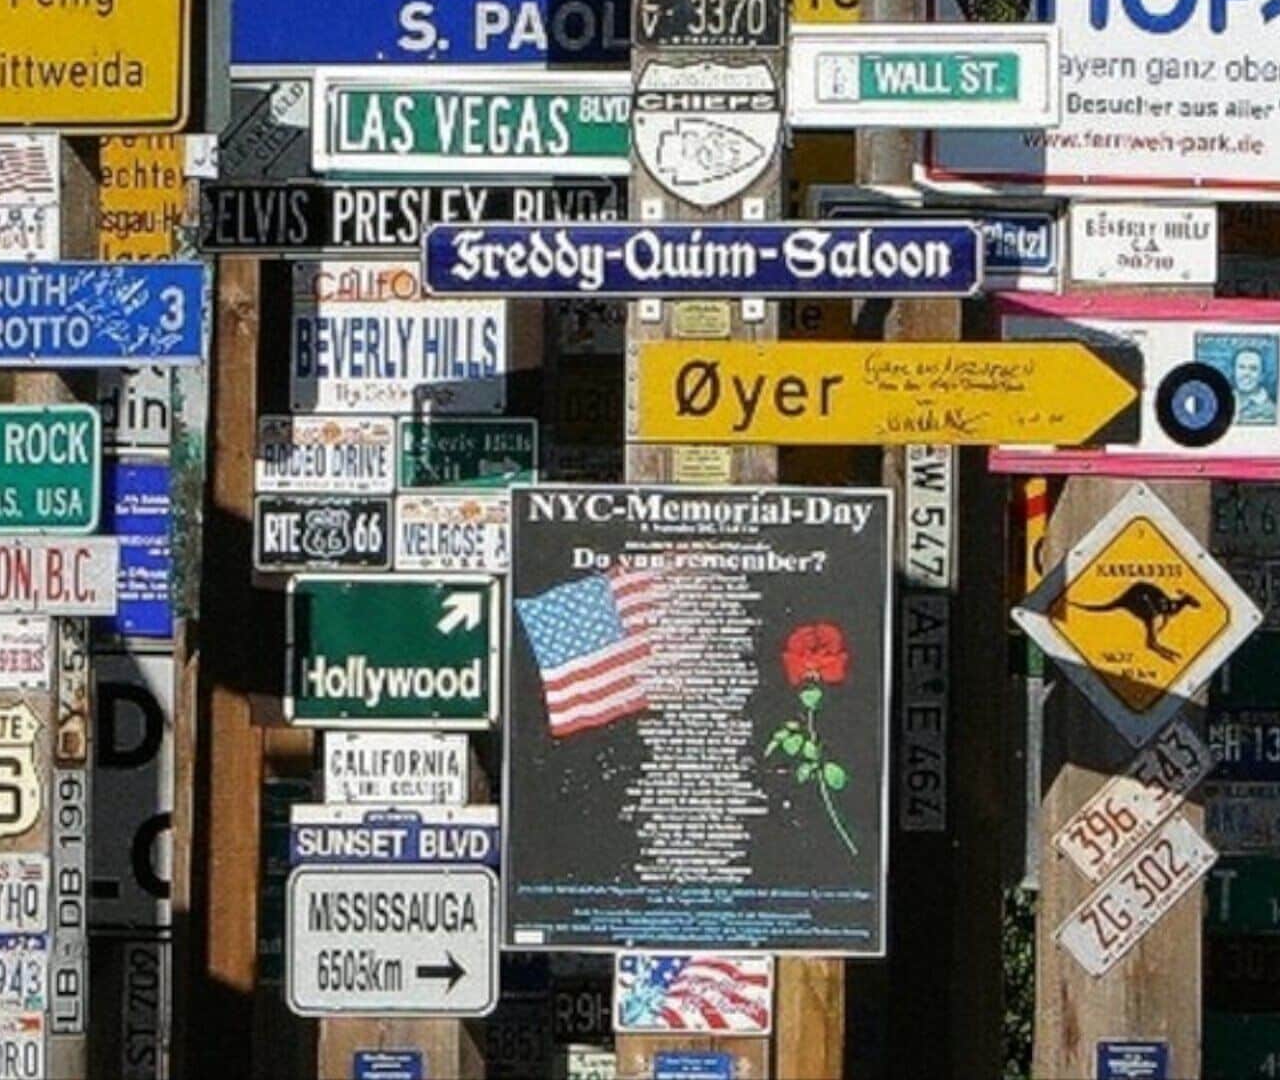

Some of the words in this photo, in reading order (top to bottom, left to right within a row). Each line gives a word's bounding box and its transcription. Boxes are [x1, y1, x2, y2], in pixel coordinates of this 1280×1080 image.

[398, 1, 450, 51] S.
[874, 60, 950, 95] WALL
[960, 60, 1008, 95] ST.
[1145, 56, 1218, 86] ganz
[637, 93, 775, 111] CHIEFS
[1066, 93, 1172, 118] Besucher
[1179, 100, 1219, 118] aus
[340, 93, 414, 154] LAS
[435, 94, 571, 156] VEGAS
[215, 189, 310, 245] ELVIS
[452, 229, 952, 291] Freddy-Quinn-Saloon
[158, 289, 186, 331] 3
[296, 316, 415, 379] BEVERLY
[422, 316, 498, 379] HILLS
[674, 359, 843, 430] Øyer
[3, 423, 88, 465] ROCK
[264, 443, 326, 478] RODEO
[332, 443, 387, 479] DRIVE
[37, 486, 83, 515] USA
[528, 493, 872, 533] NYC-Memorial-Day
[263, 512, 302, 553] RTE
[353, 512, 382, 553] 66
[45, 547, 97, 603] B.C.
[573, 547, 610, 570] Do
[303, 656, 482, 707] Hollywood
[331, 749, 459, 778] CALIFORNIA
[297, 829, 407, 859] SUNSET
[421, 830, 489, 859] BLVD
[309, 891, 478, 934] MISSISSAUGA
